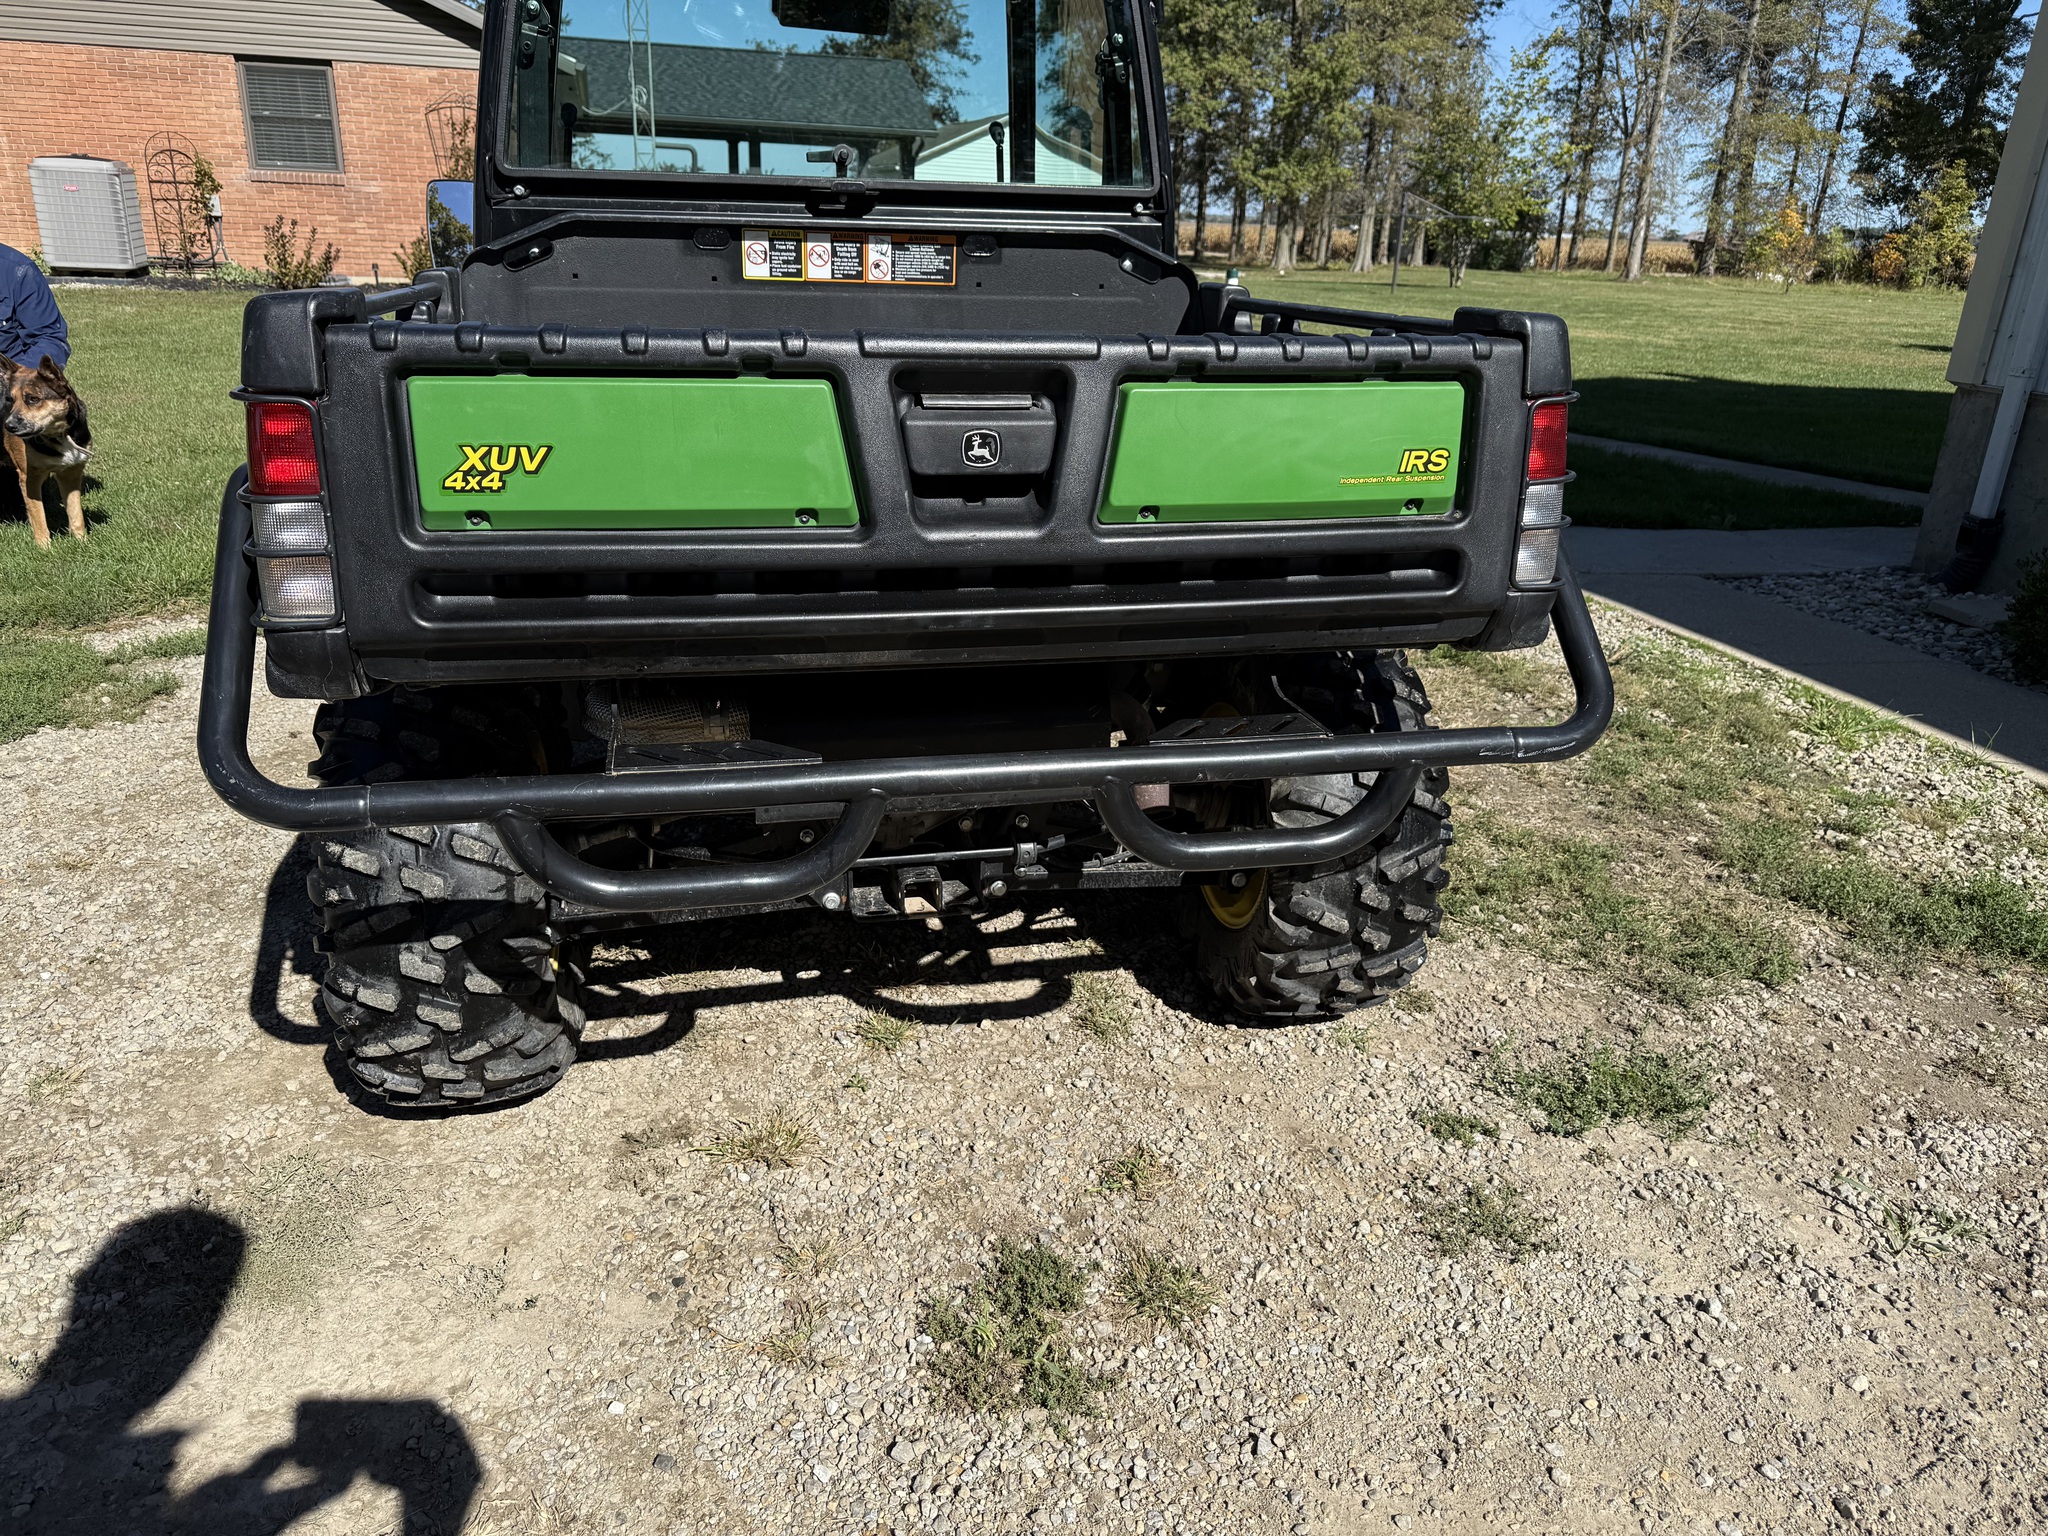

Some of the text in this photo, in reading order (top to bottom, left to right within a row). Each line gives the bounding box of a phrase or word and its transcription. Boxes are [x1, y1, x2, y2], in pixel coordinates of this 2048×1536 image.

[458, 445, 551, 473] XUV
[1399, 448, 1451, 473] IRS
[442, 471, 504, 491] 4x4
[1339, 473, 1445, 485] Independent Rear Suspension
